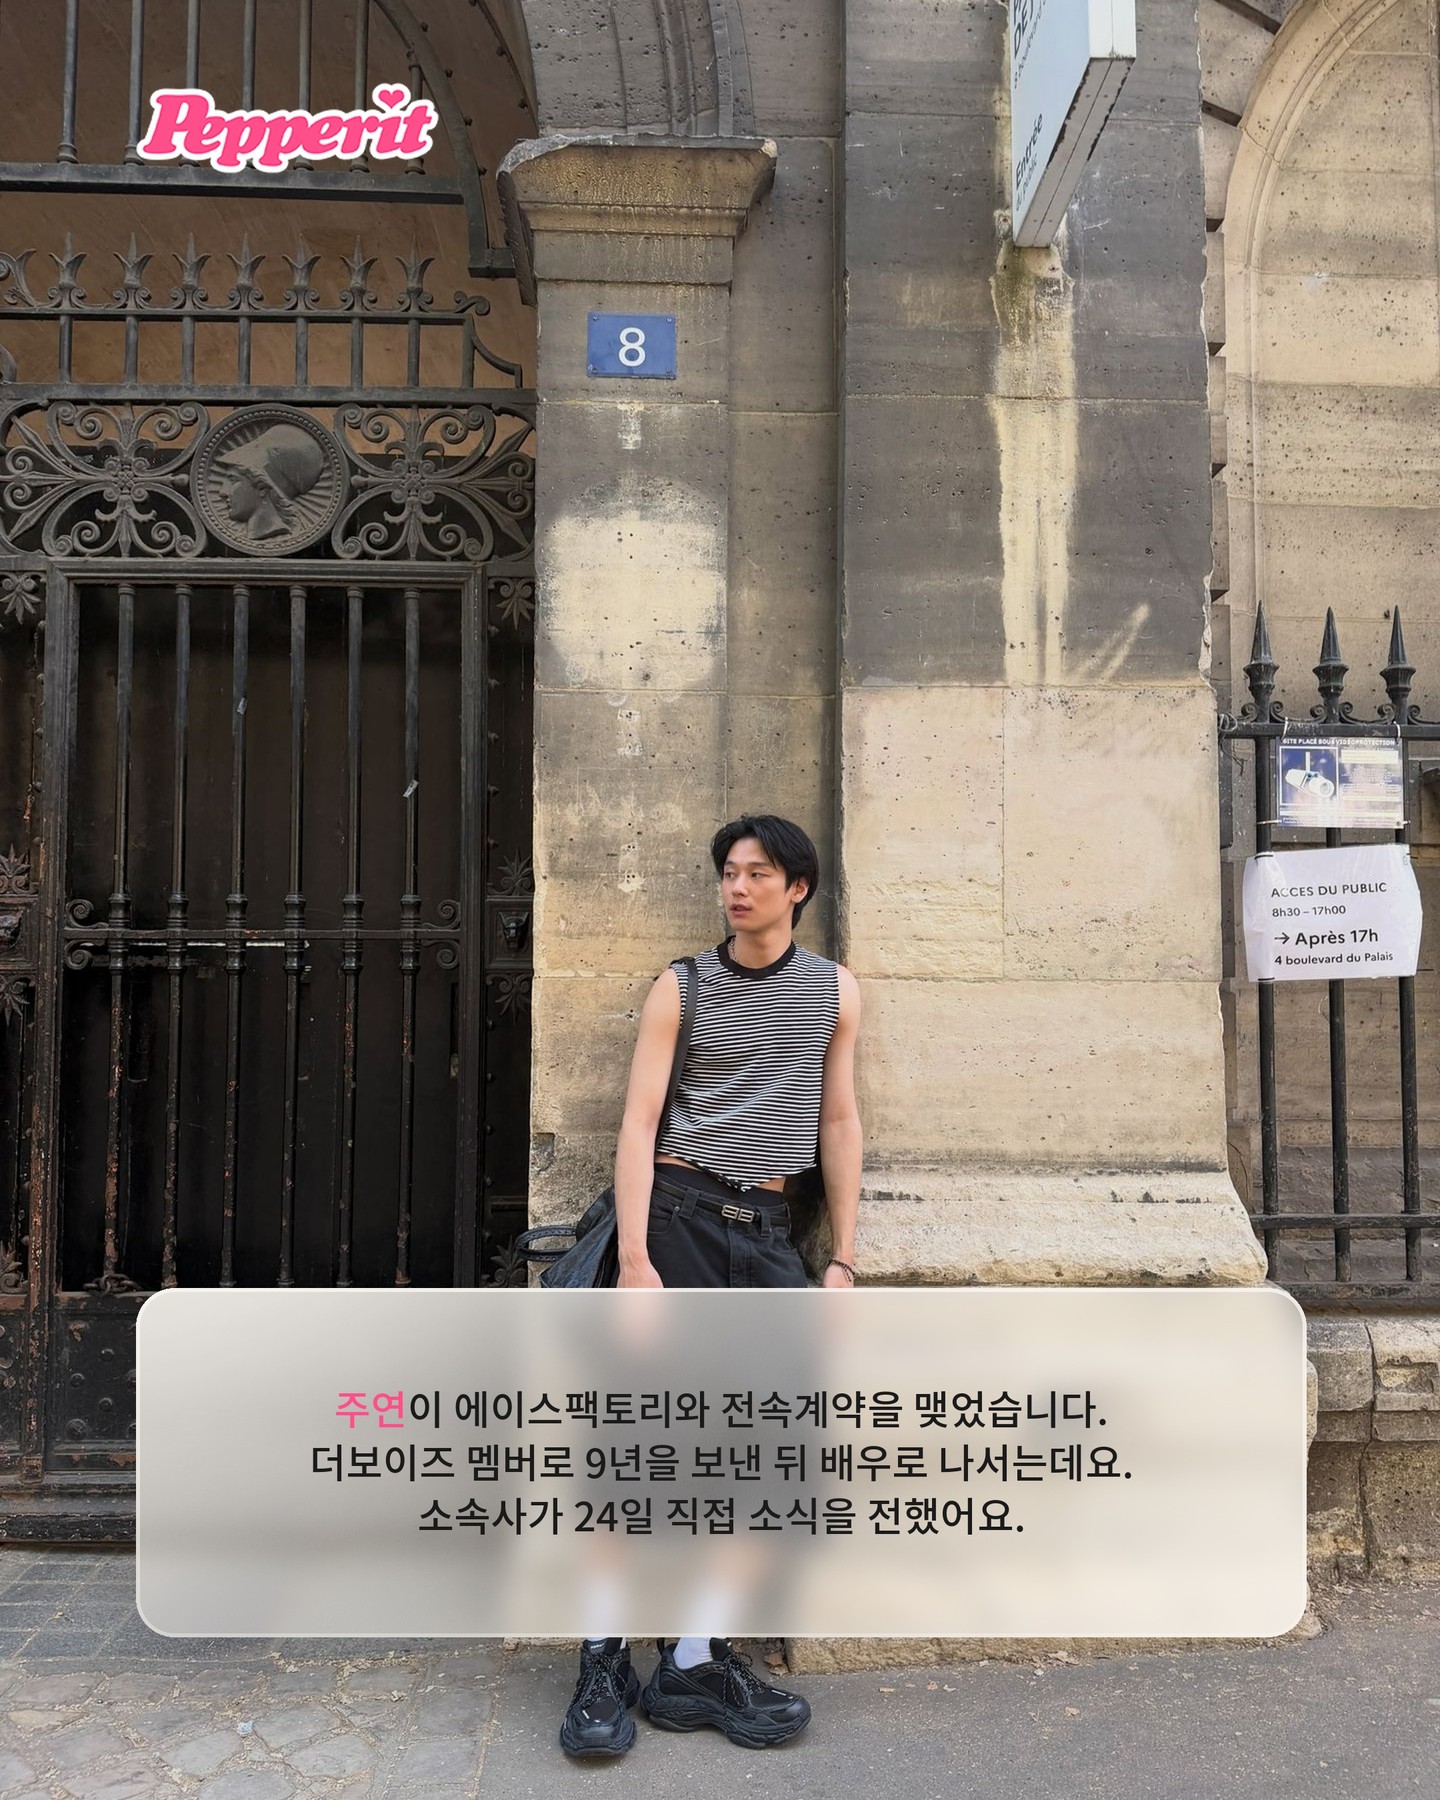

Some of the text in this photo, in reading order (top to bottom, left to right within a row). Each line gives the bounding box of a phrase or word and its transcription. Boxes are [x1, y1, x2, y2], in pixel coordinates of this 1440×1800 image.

[1016, 113, 1042, 190] Entrée
[618, 326, 646, 368] 8
[1271, 882, 1387, 898] ACCES DU PUBLIC
[1272, 907, 1301, 918] 8h30
[1312, 905, 1346, 916] 17h00
[1295, 928, 1379, 949] Après 17h
[1274, 951, 1394, 965] 4 boulevard du Palais
